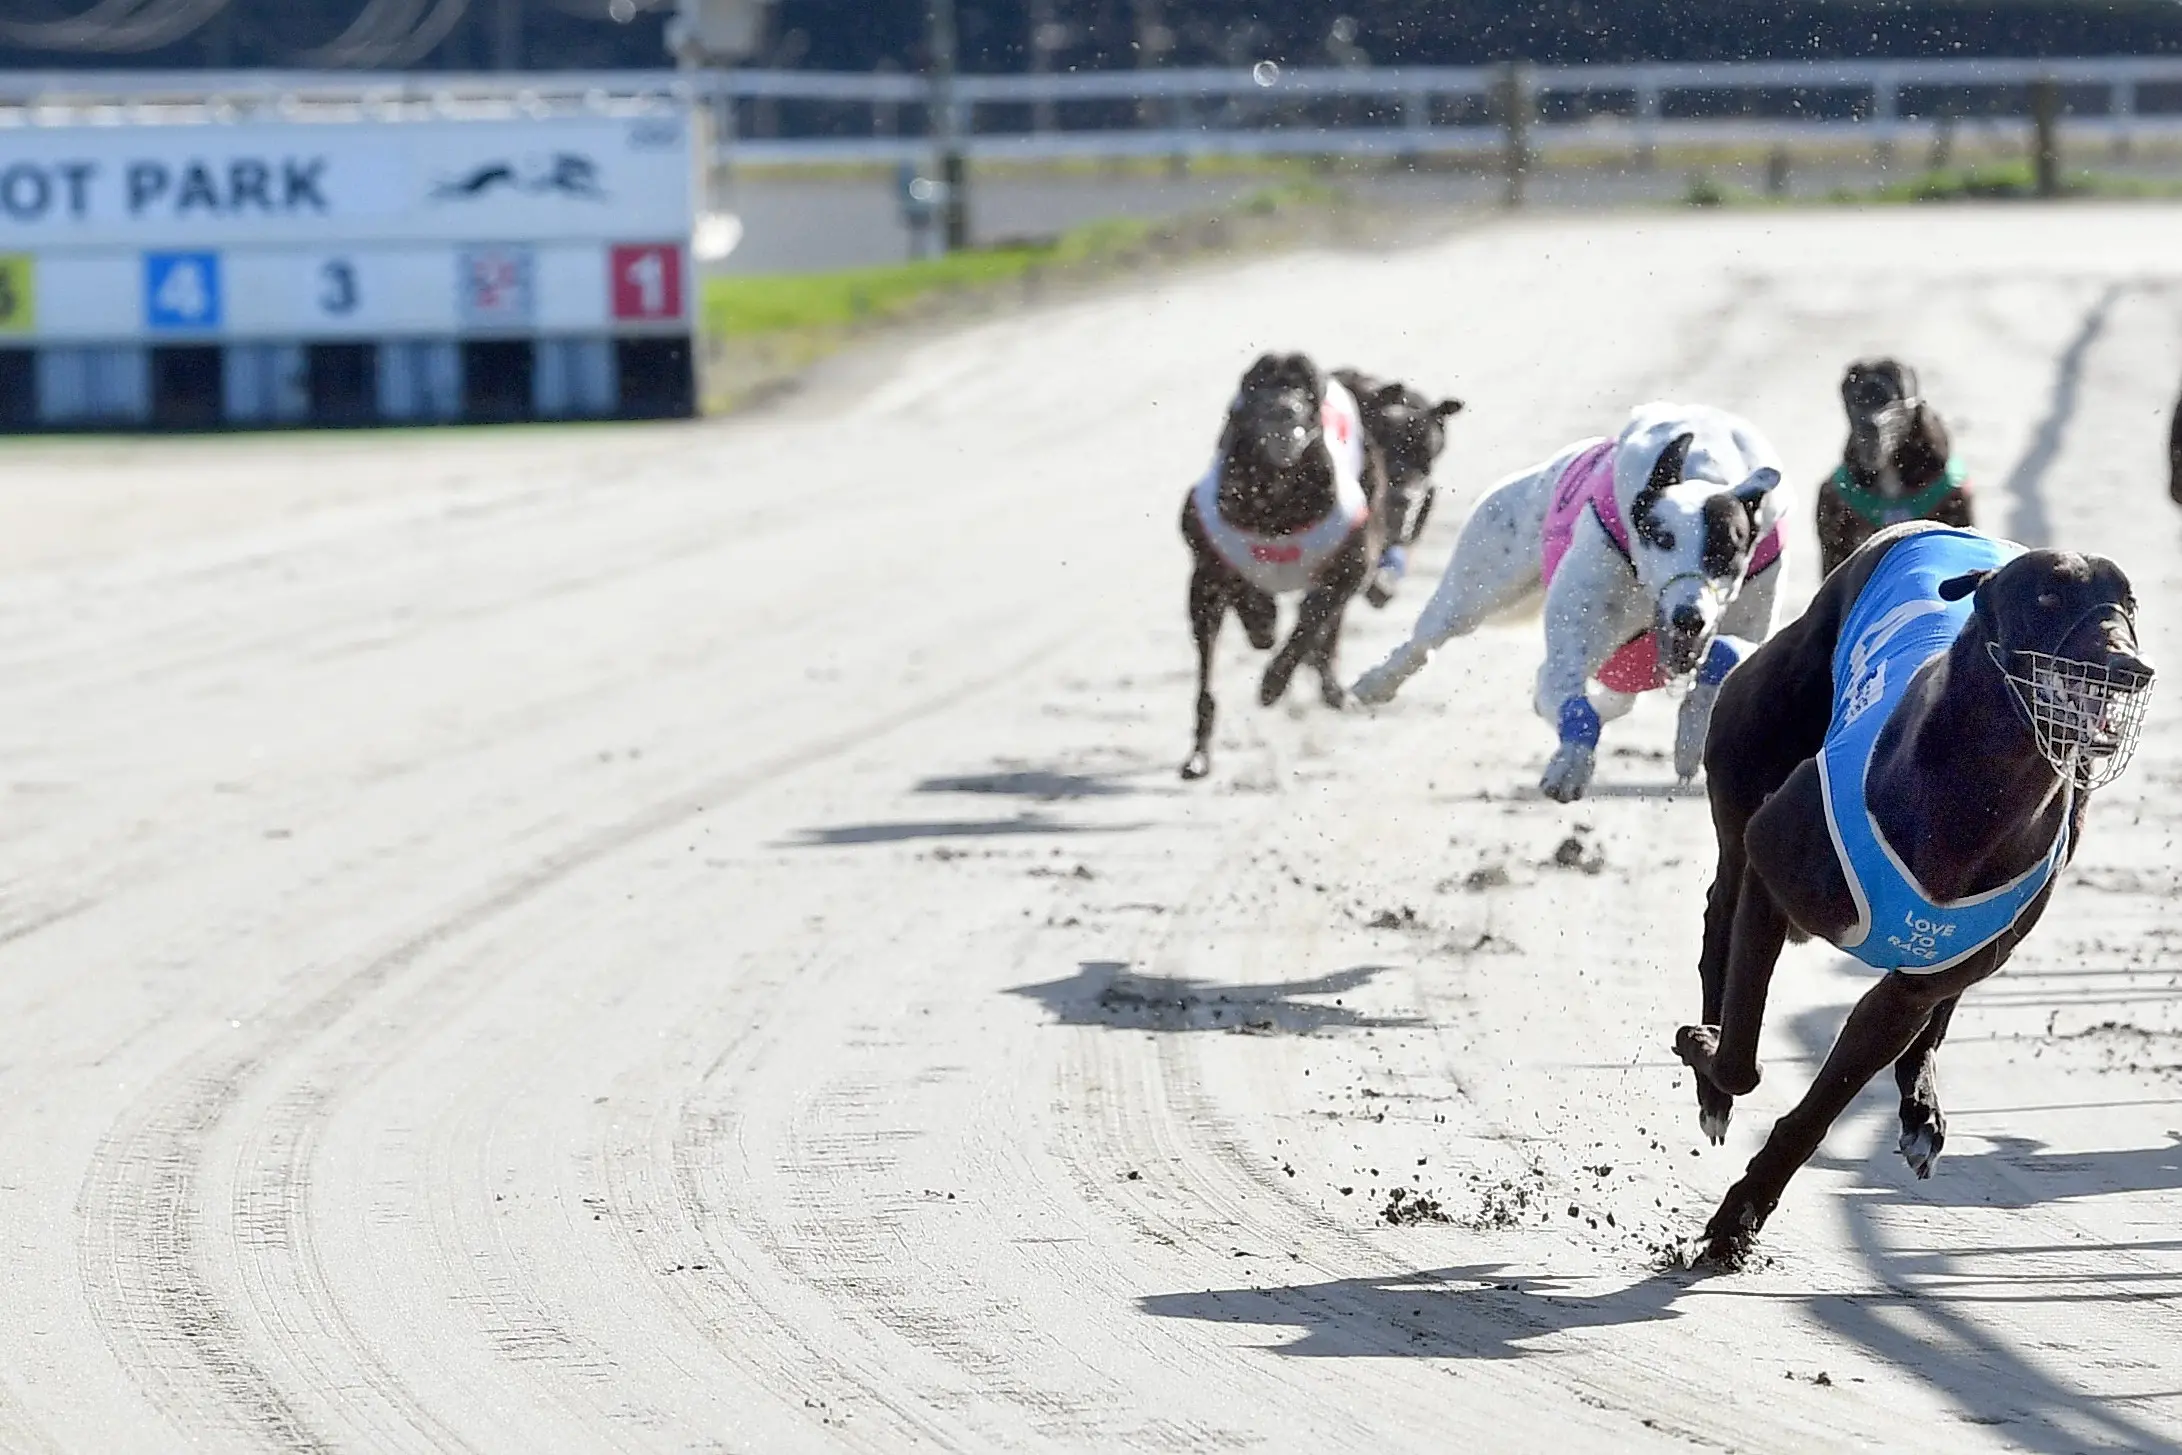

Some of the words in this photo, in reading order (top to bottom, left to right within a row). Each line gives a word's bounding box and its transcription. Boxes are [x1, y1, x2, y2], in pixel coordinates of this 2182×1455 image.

[126, 156, 328, 217] PARK
[157, 260, 209, 318] 4
[318, 258, 359, 315] 3
[626, 252, 667, 312] 1
[1904, 909, 1957, 937] LOVE
[1887, 935, 1939, 960] RACE
[1909, 931, 1935, 948] TO
